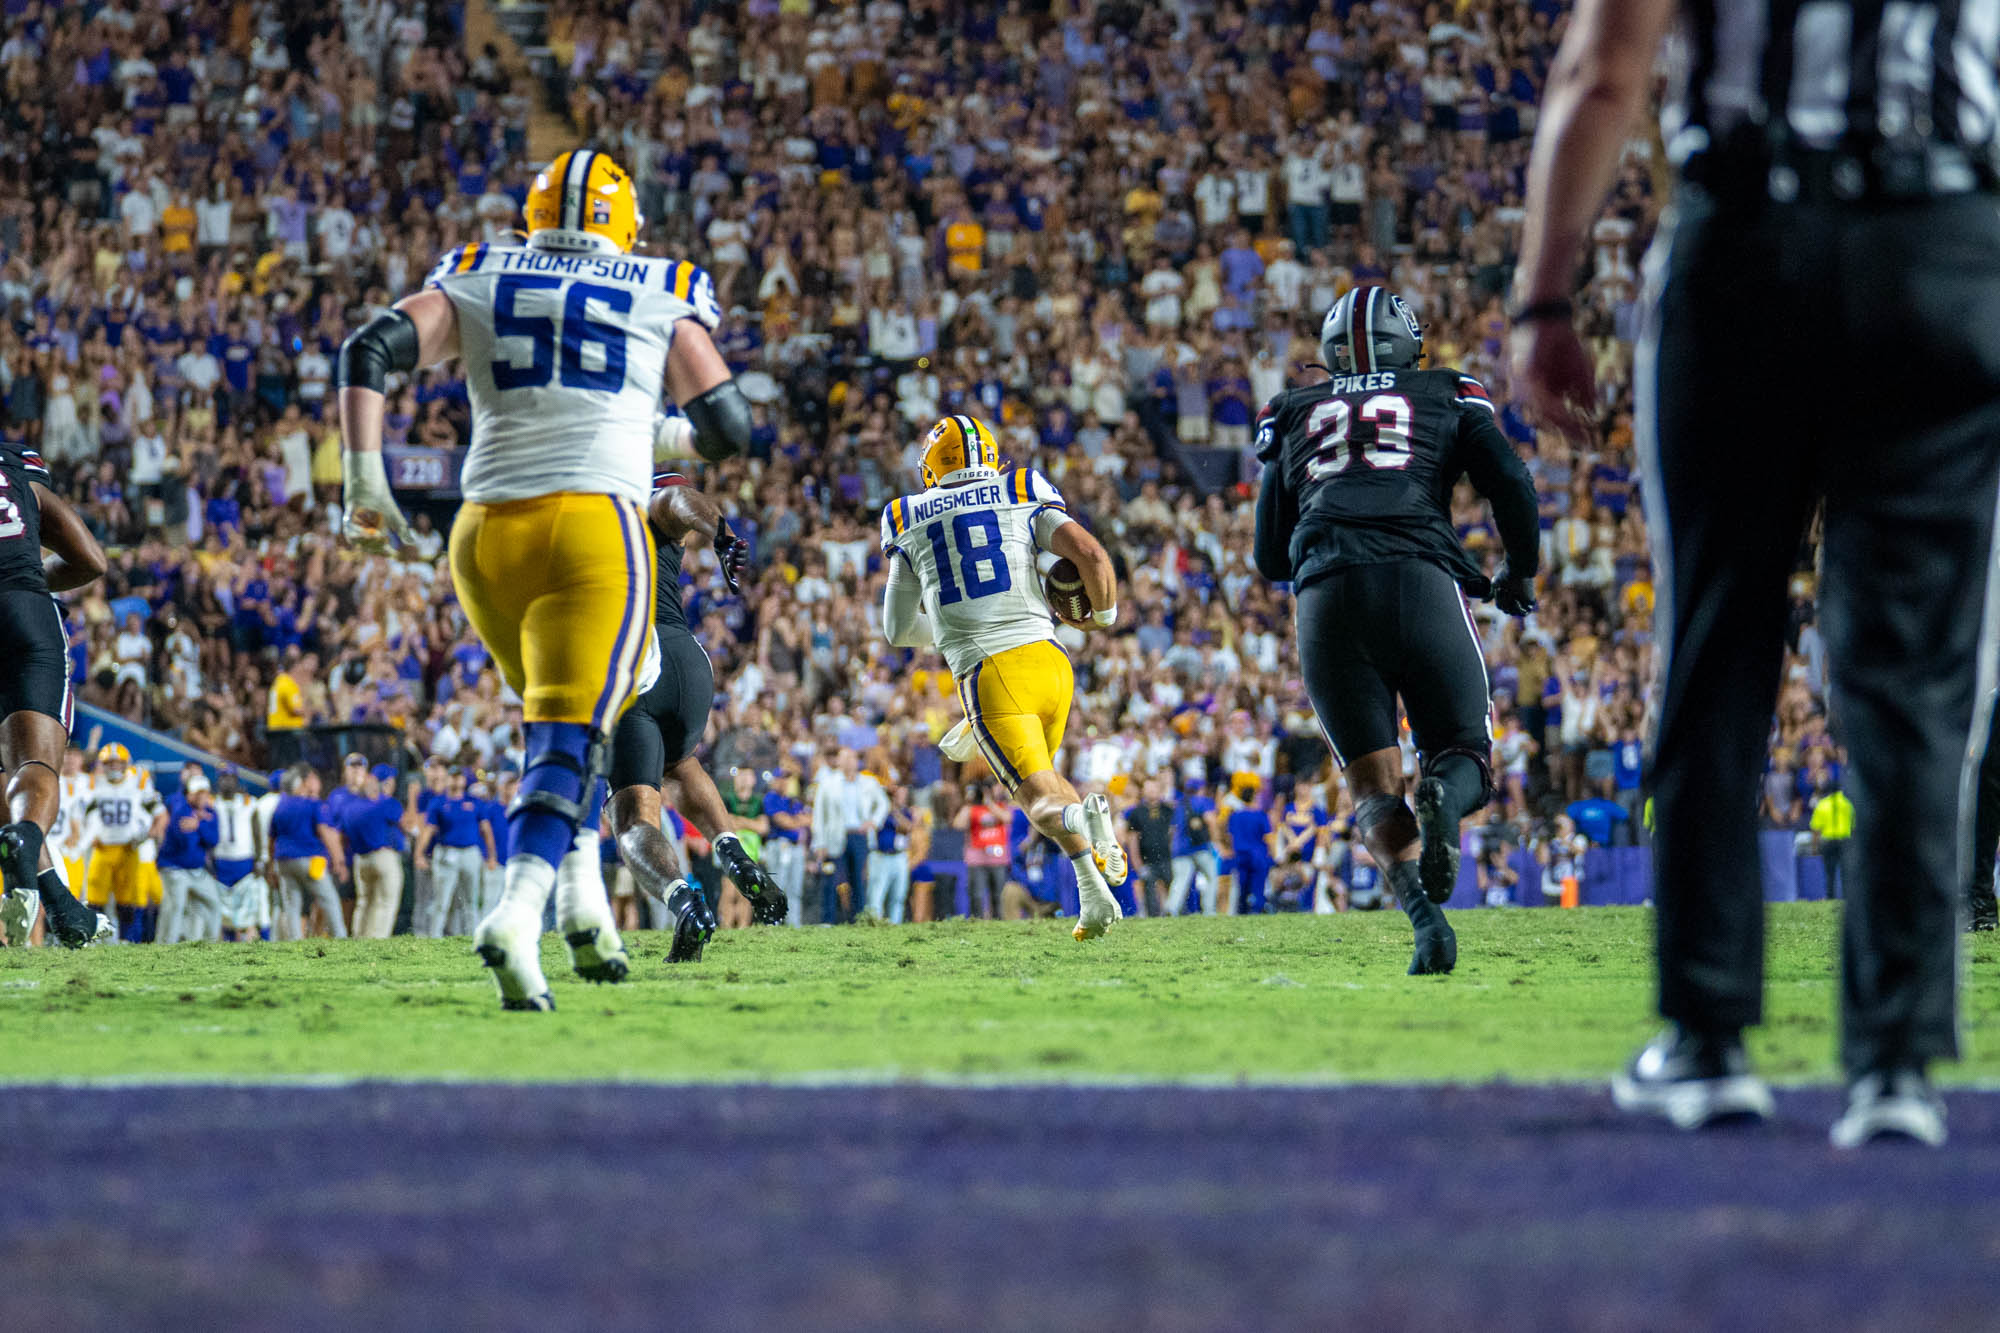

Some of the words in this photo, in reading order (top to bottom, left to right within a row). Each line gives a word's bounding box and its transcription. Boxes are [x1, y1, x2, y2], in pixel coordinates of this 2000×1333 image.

[502, 252, 649, 285] THOMPSON
[491, 274, 633, 394] 56
[1332, 372, 1396, 395] PIKES
[1305, 392, 1415, 482] 33
[957, 470, 995, 480] TIGERS
[914, 484, 1001, 524] NUSSMEIER
[926, 509, 1011, 606] 18
[100, 799, 131, 826] 68
